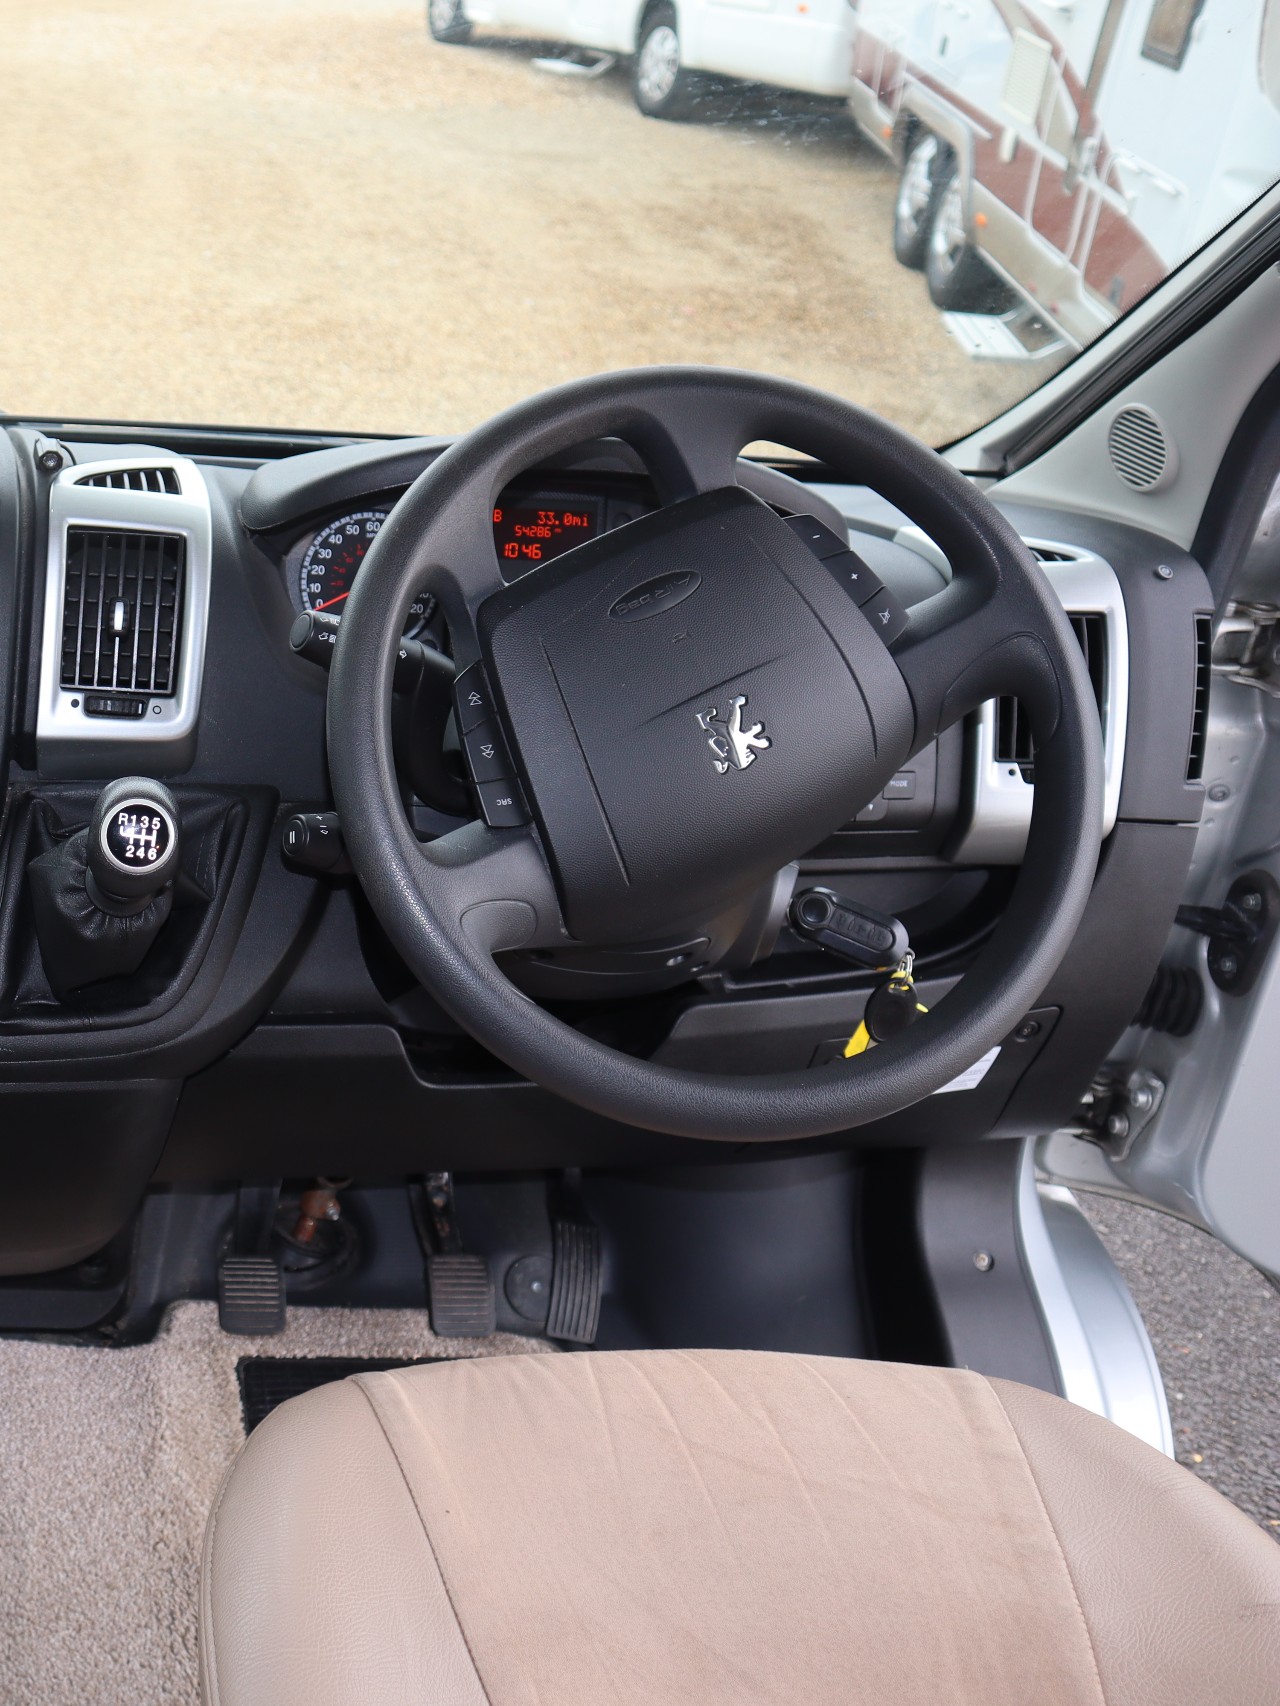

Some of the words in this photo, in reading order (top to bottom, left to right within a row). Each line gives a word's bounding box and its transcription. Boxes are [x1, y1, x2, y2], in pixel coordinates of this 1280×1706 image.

[493, 509, 502, 522] B
[346, 525, 360, 534] 50
[366, 521, 380, 531] 60
[514, 525, 552, 538] 54286
[328, 534, 343, 544] 40
[318, 548, 332, 558] 30
[311, 565, 325, 575] 20
[310, 583, 321, 592] 10
[410, 604, 424, 614] 20
[496, 798, 512, 806] SRC
